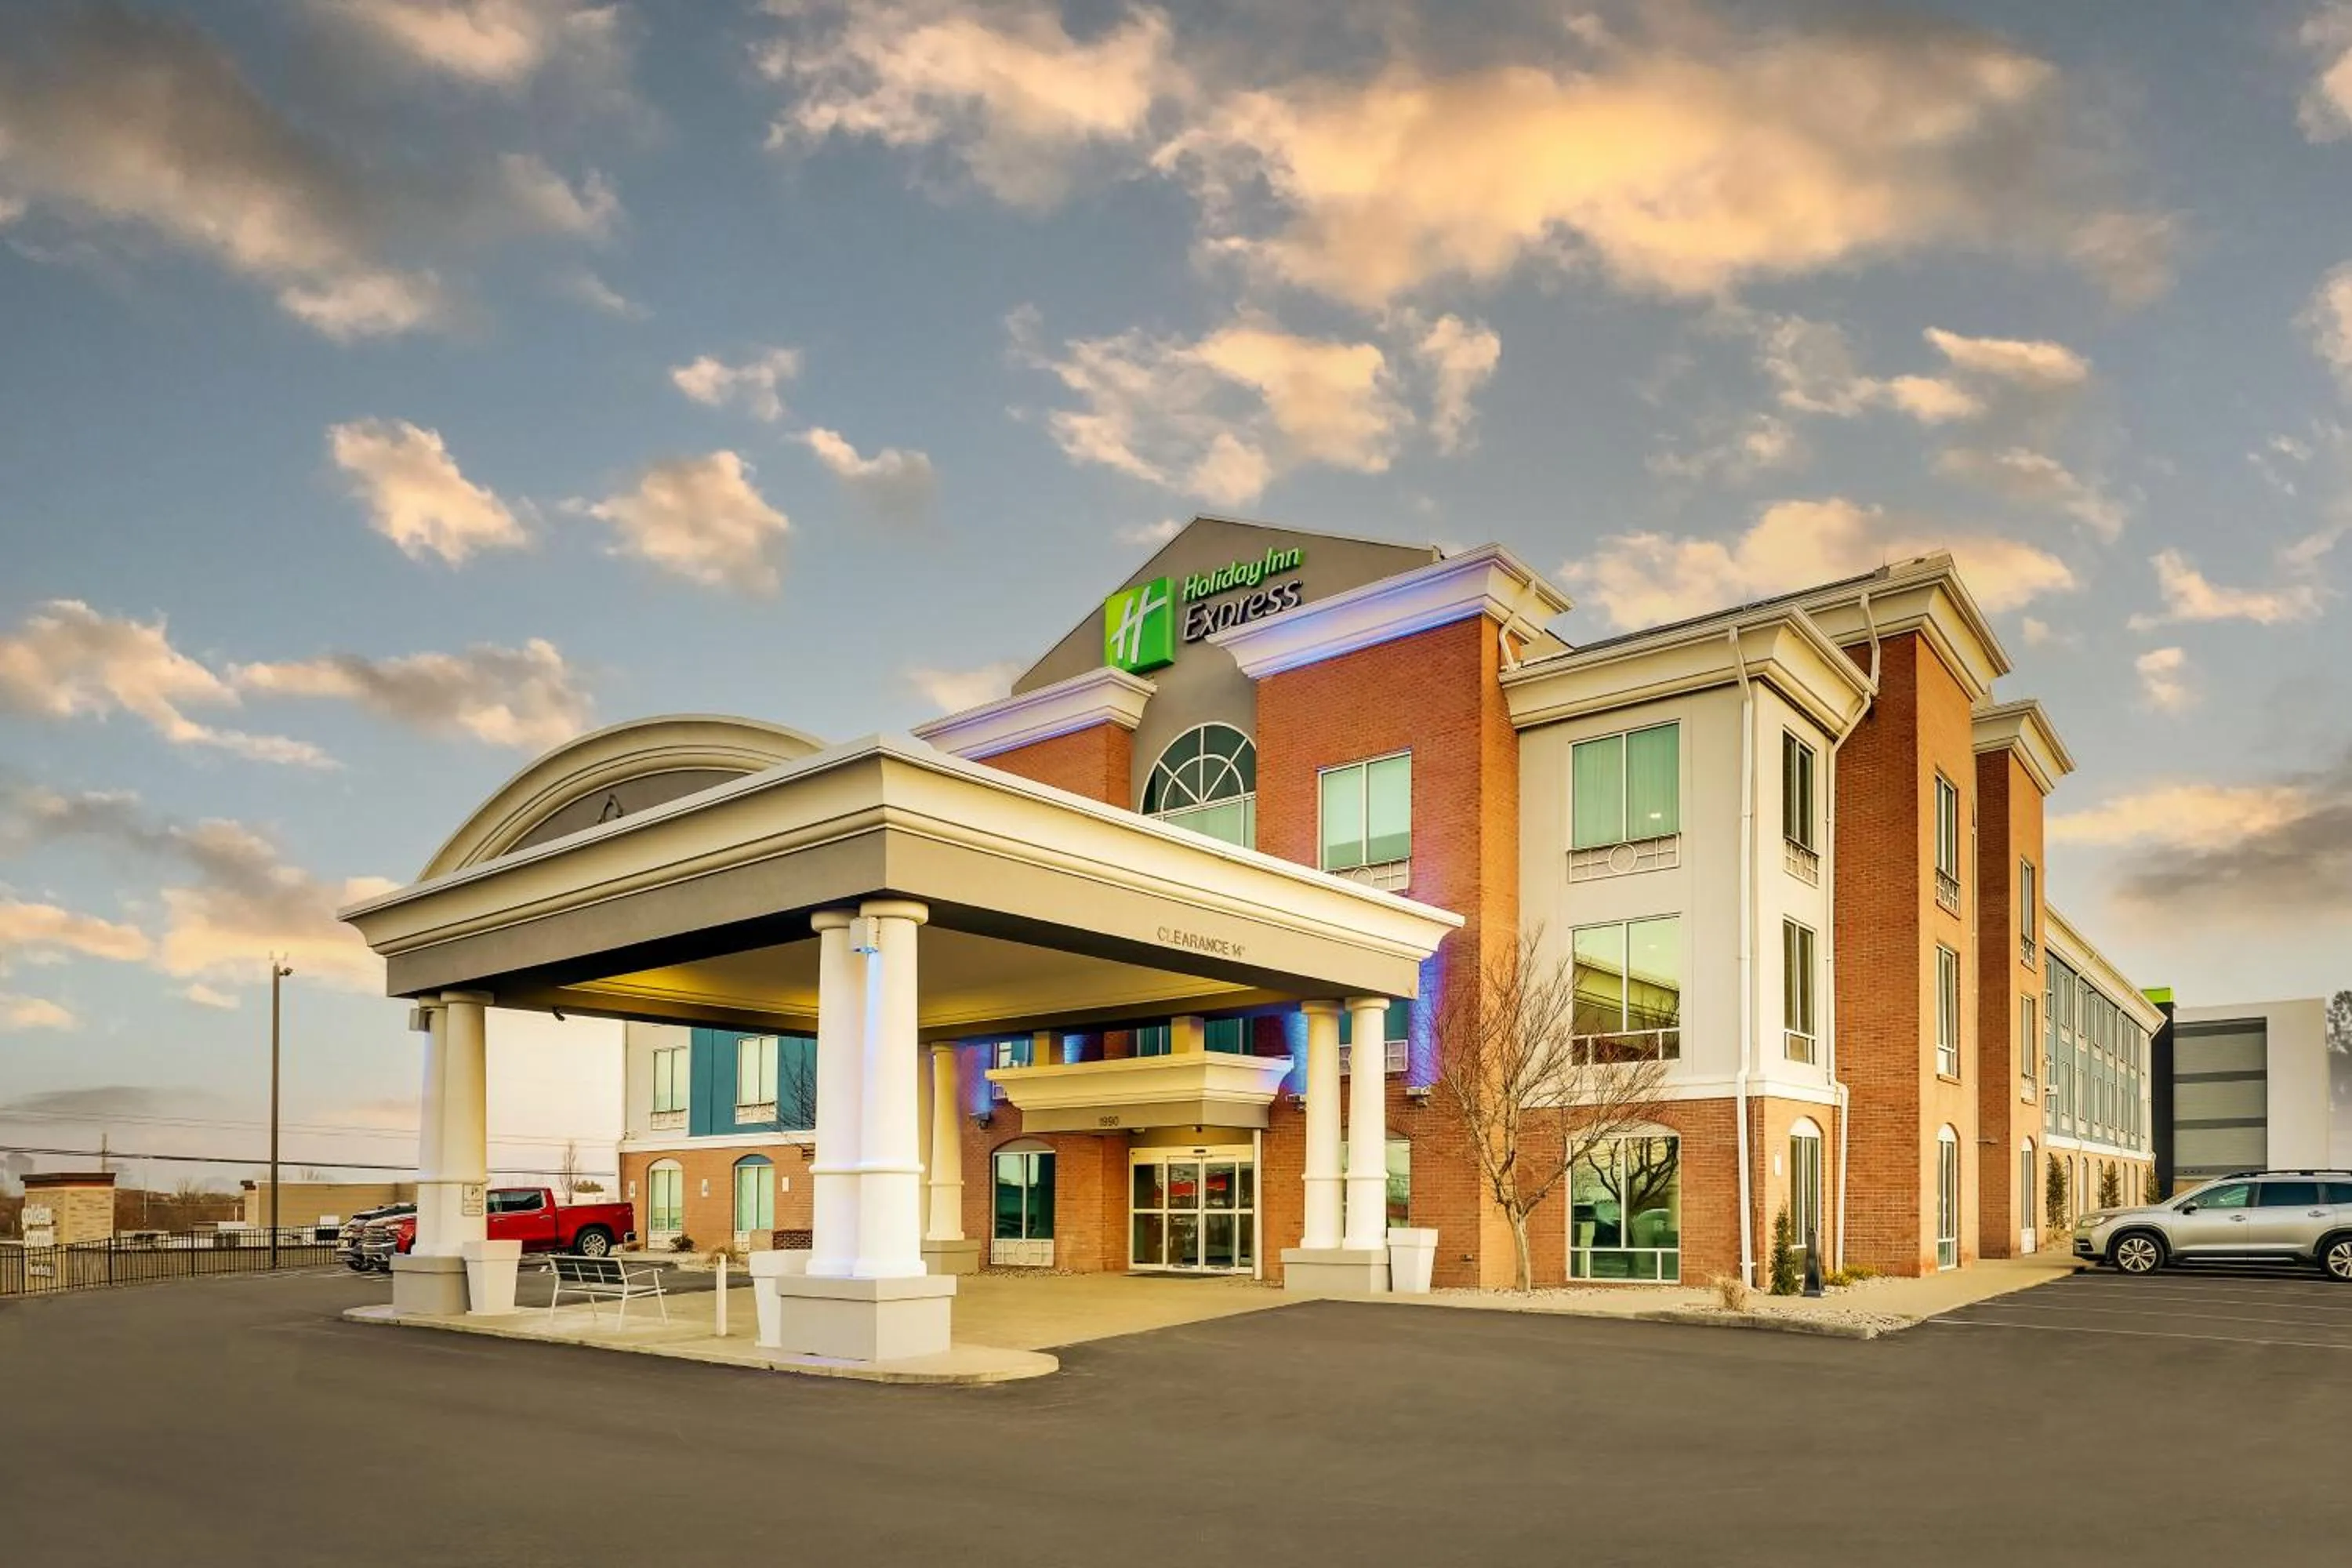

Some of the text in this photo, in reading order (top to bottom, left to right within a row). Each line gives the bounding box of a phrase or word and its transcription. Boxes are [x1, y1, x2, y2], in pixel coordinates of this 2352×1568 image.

[1182, 547, 1302, 601] Holiday Inn
[1109, 585, 1167, 664] H
[1183, 579, 1302, 642] Express
[1157, 926, 1229, 955] CLEARANCE
